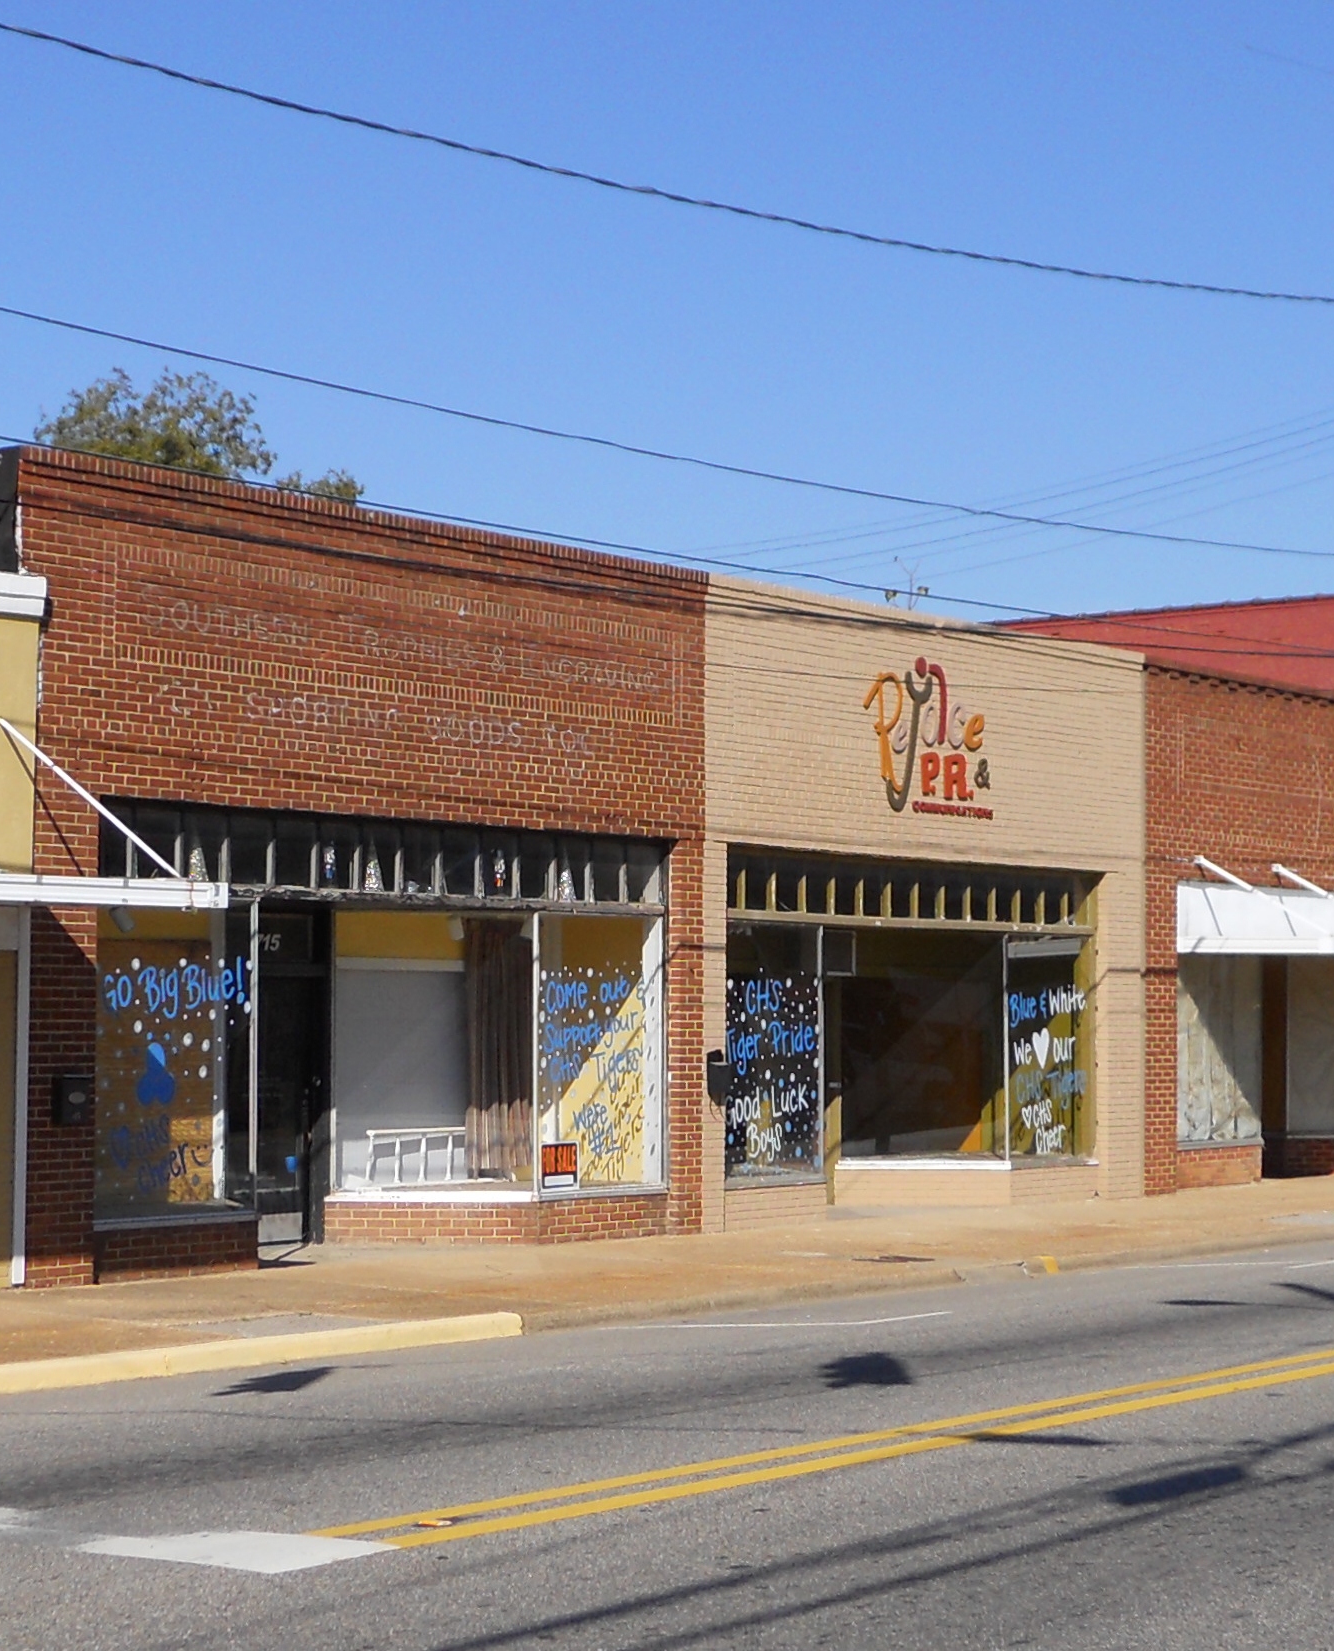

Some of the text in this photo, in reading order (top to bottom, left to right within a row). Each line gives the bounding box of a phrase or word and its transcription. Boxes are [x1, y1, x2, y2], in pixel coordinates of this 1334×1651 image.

[137, 965, 178, 1019] Big
[182, 956, 246, 1010] Blue!
[599, 974, 631, 1004] out
[745, 979, 783, 1014] CHS
[1009, 991, 1037, 1028] Blue
[725, 1021, 816, 1076] Tiger Pride
[1013, 1036, 1076, 1066] We our
[549, 1052, 581, 1083] CHS
[725, 1086, 760, 1130] Good
[1032, 1098, 1053, 1128] CHS
[542, 1145, 576, 1174] FOR SALE
[747, 1122, 783, 1162] Boys
